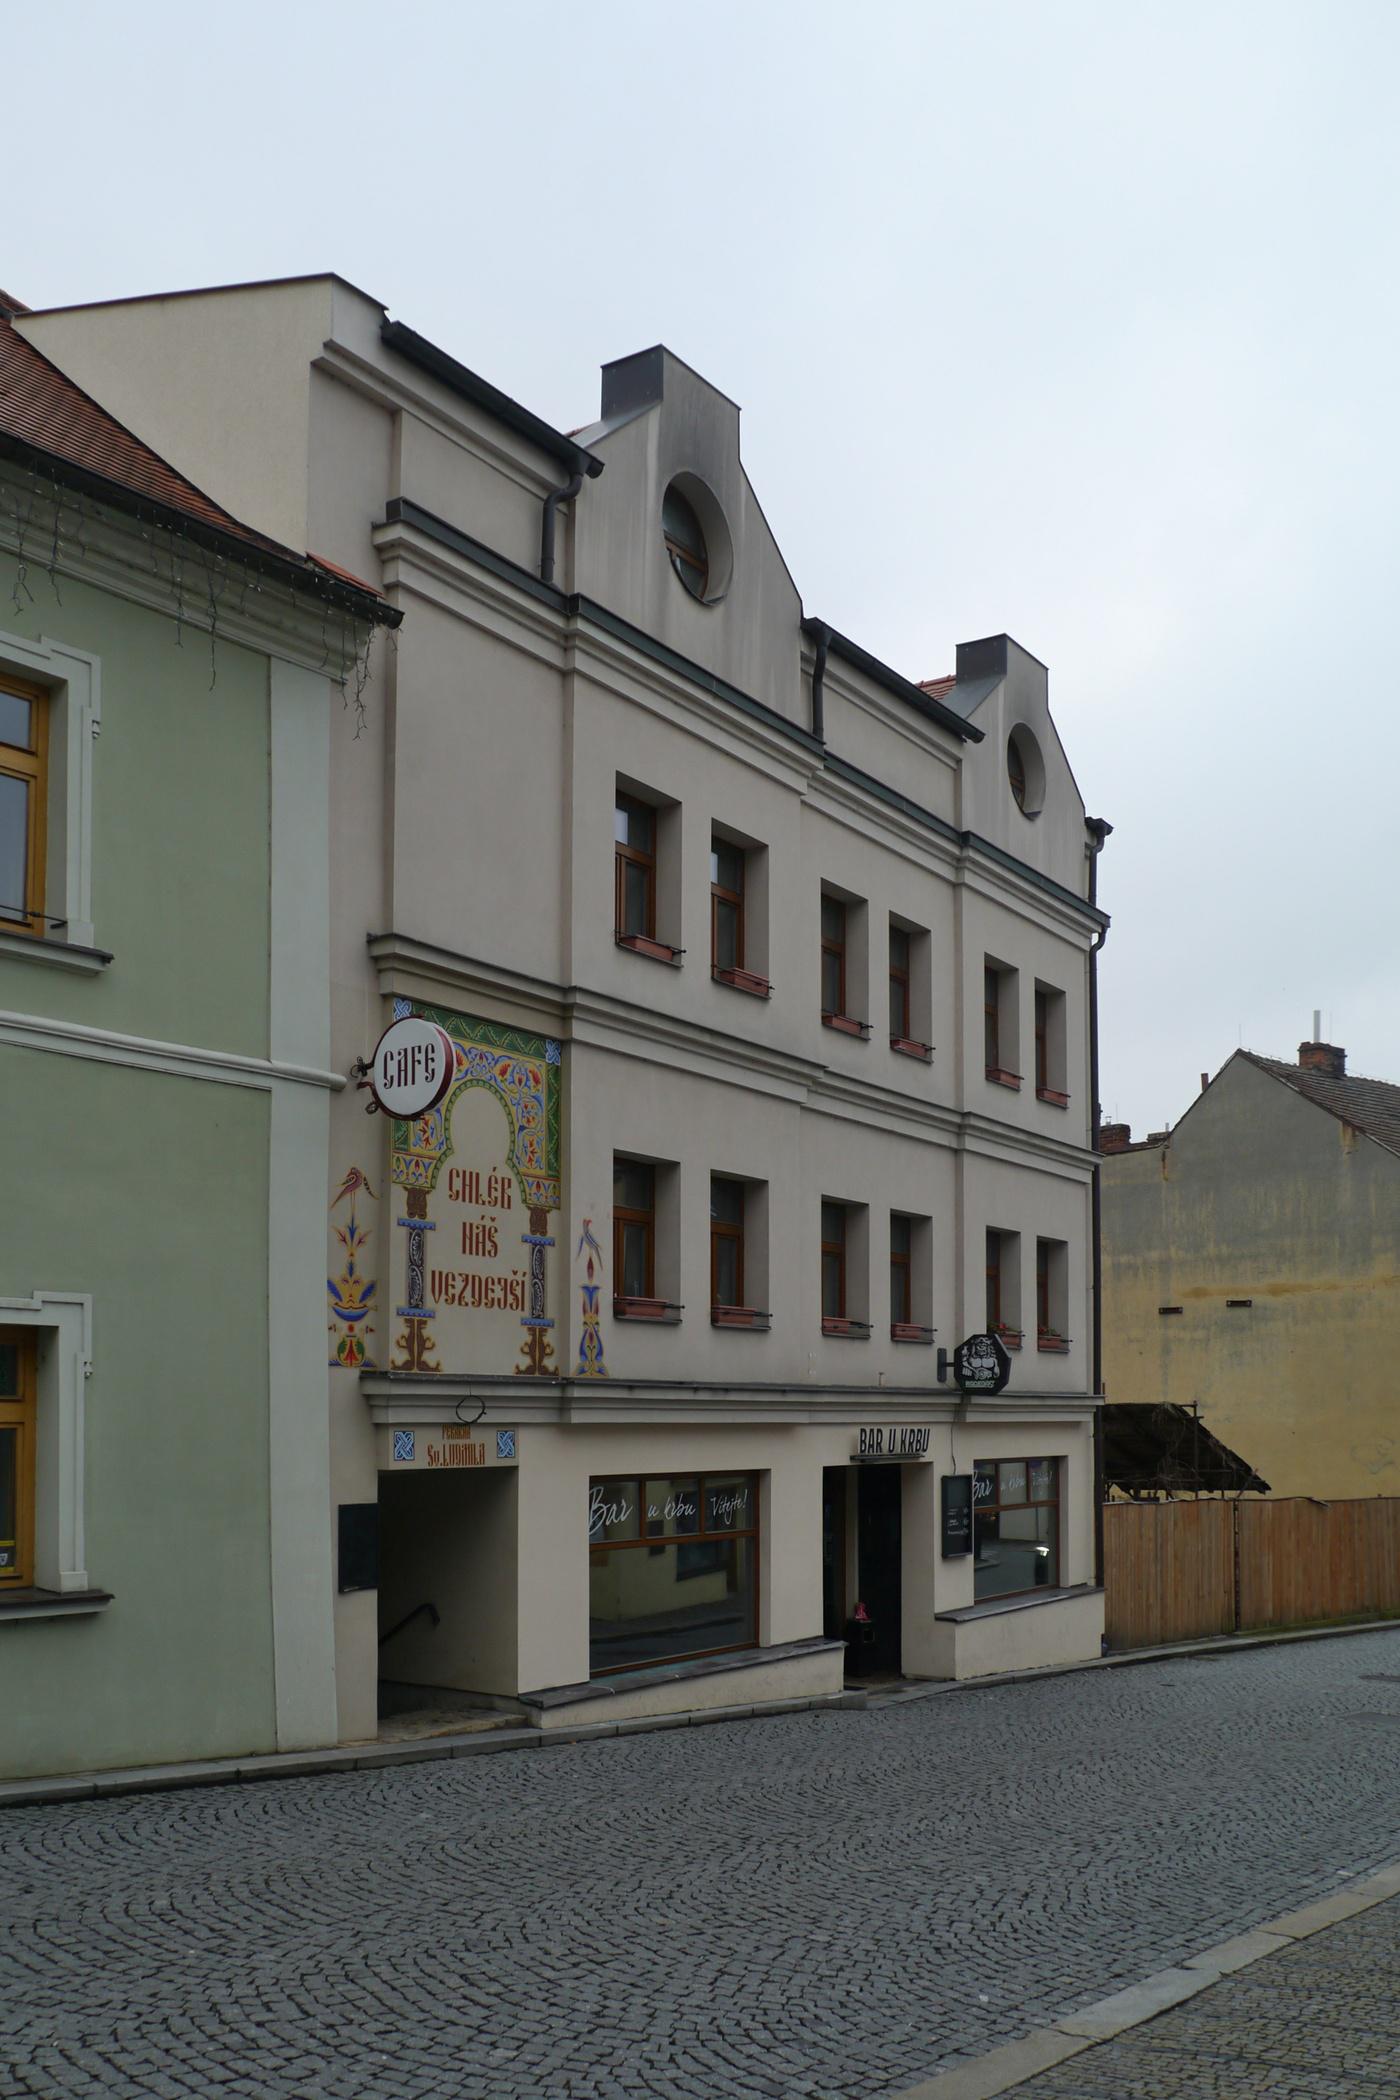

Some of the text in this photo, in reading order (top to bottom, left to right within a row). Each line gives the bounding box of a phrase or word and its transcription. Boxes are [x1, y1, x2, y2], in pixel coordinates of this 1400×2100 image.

[383, 1042, 435, 1090] CAFE
[448, 1166, 512, 1210] CHLÉB
[461, 1214, 498, 1258] NÁŠ
[431, 1269, 527, 1312] VEZDEJŠÍ
[859, 1428, 930, 1454] BAR U KRBU
[589, 1486, 633, 1536] Bar
[648, 1505, 660, 1518] u
[664, 1493, 696, 1520] krbu
